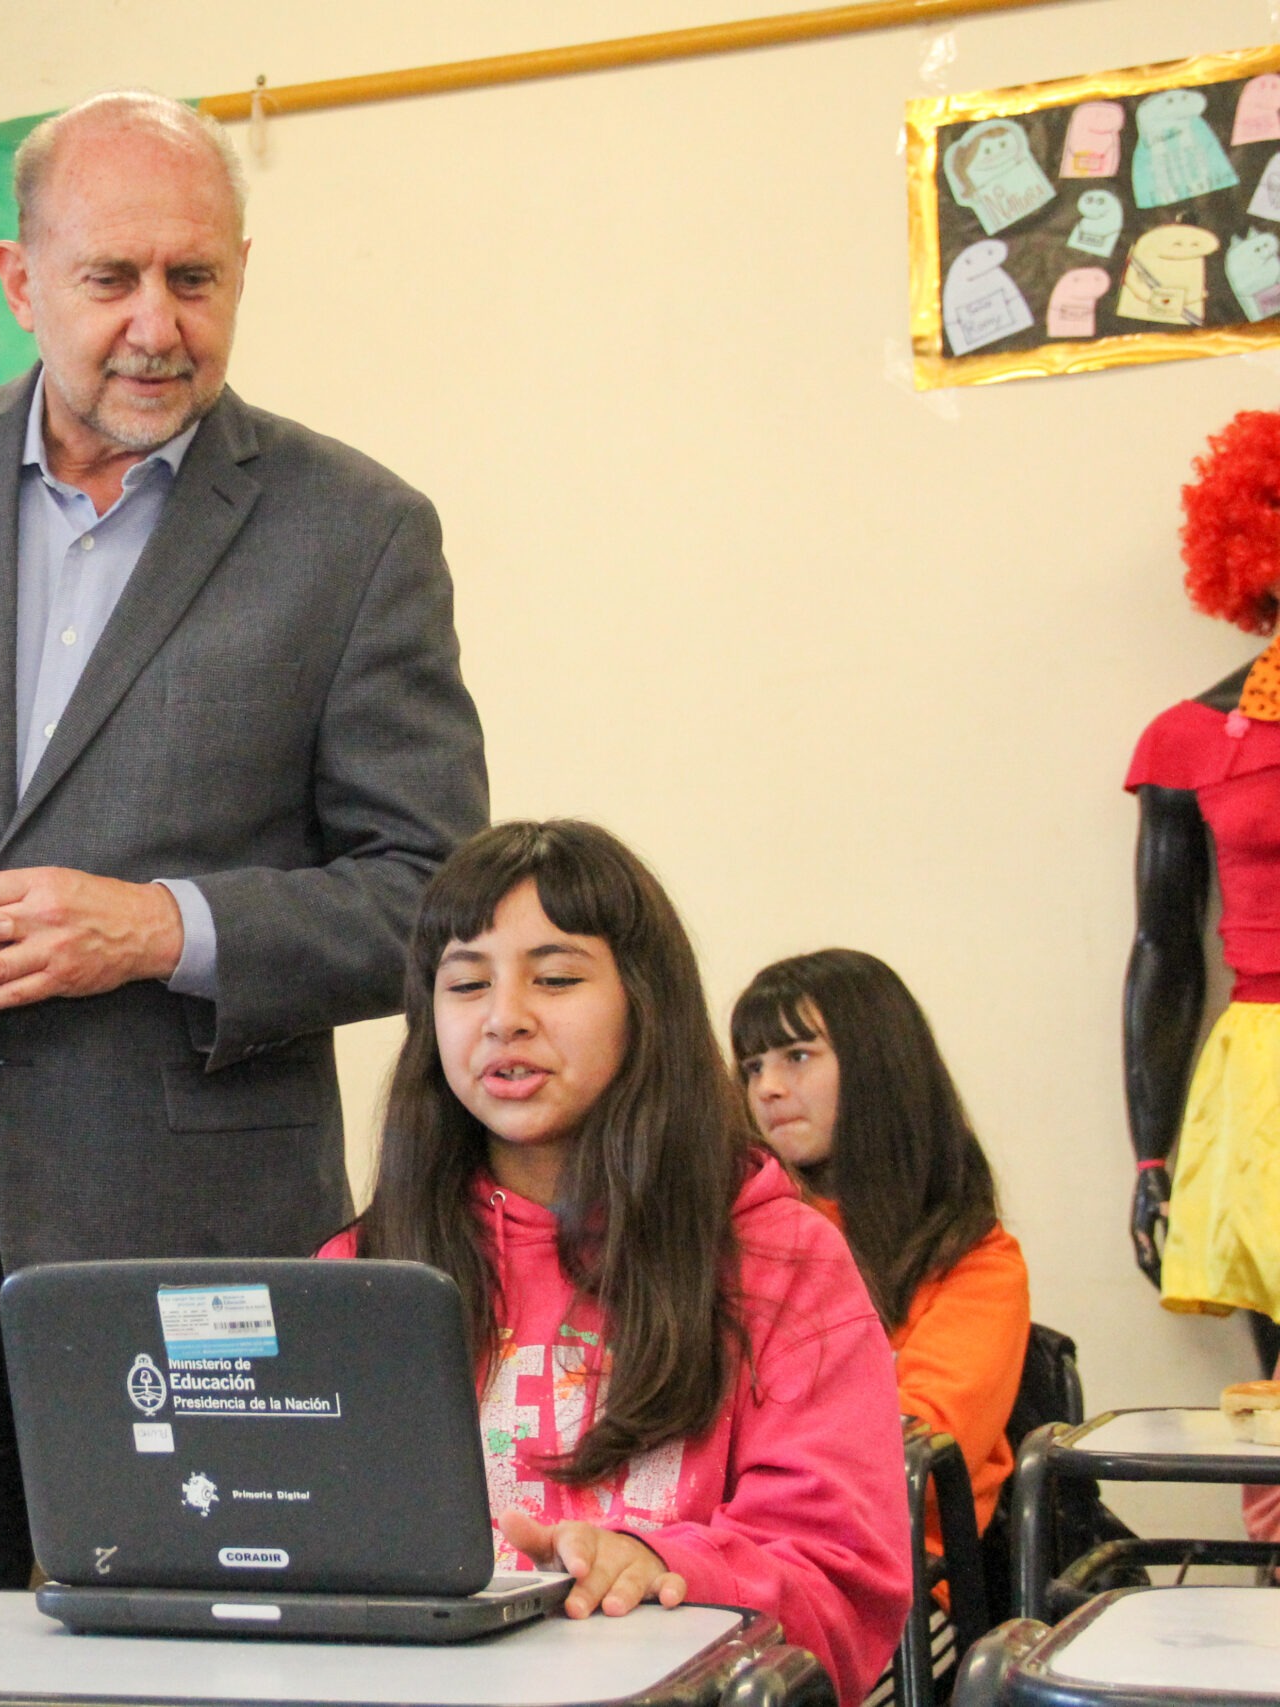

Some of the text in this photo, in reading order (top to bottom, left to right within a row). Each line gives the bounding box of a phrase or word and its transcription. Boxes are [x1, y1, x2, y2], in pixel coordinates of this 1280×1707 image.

[169, 1357, 251, 1371] Ministerio de
[170, 1373, 255, 1391] Educación
[173, 1396, 331, 1412] Presidencia de la Nación
[232, 1490, 310, 1501] Primaria Digital
[226, 1552, 282, 1562] CORADIR
